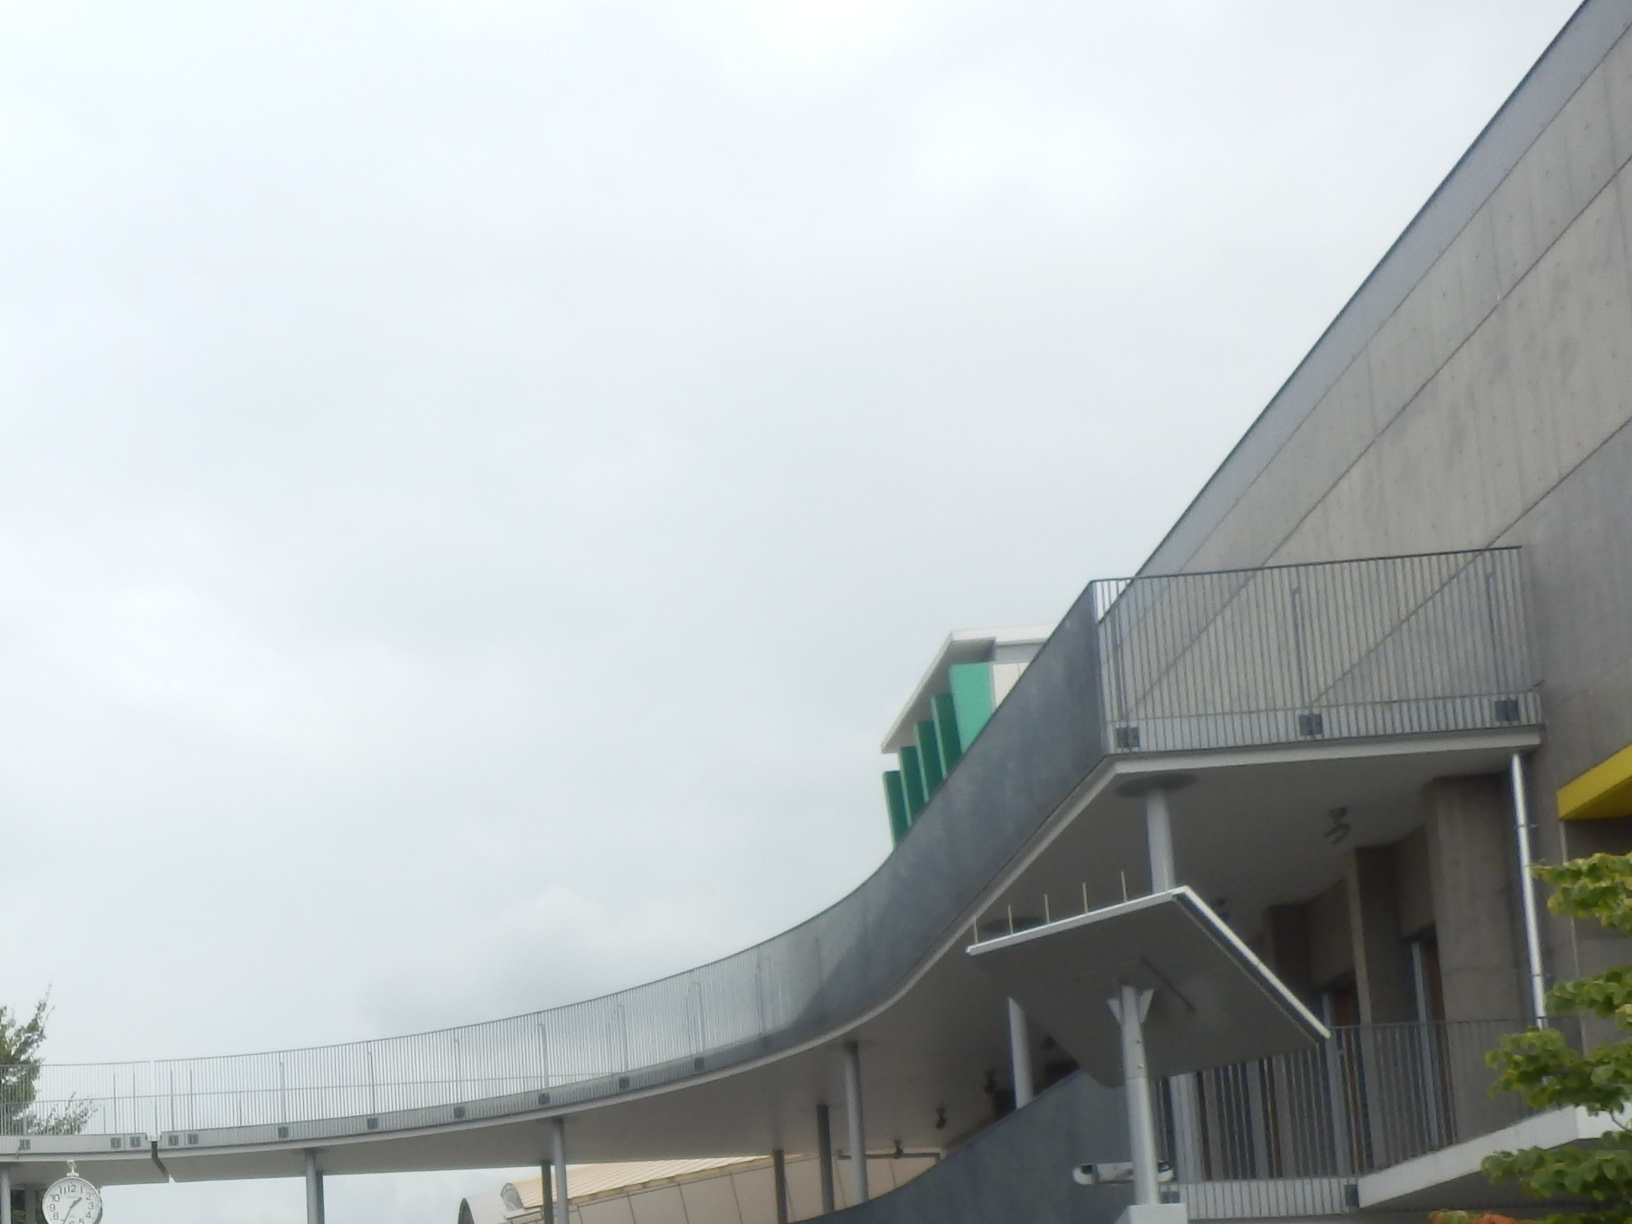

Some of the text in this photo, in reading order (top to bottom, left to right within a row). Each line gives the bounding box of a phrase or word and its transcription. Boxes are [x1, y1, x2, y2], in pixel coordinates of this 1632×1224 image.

[68, 1184, 76, 1193] 12
[49, 1194, 60, 1202] 10
[49, 1203, 56, 1212] 9
[88, 1201, 94, 1210] 3
[53, 1212, 59, 1220] 8
